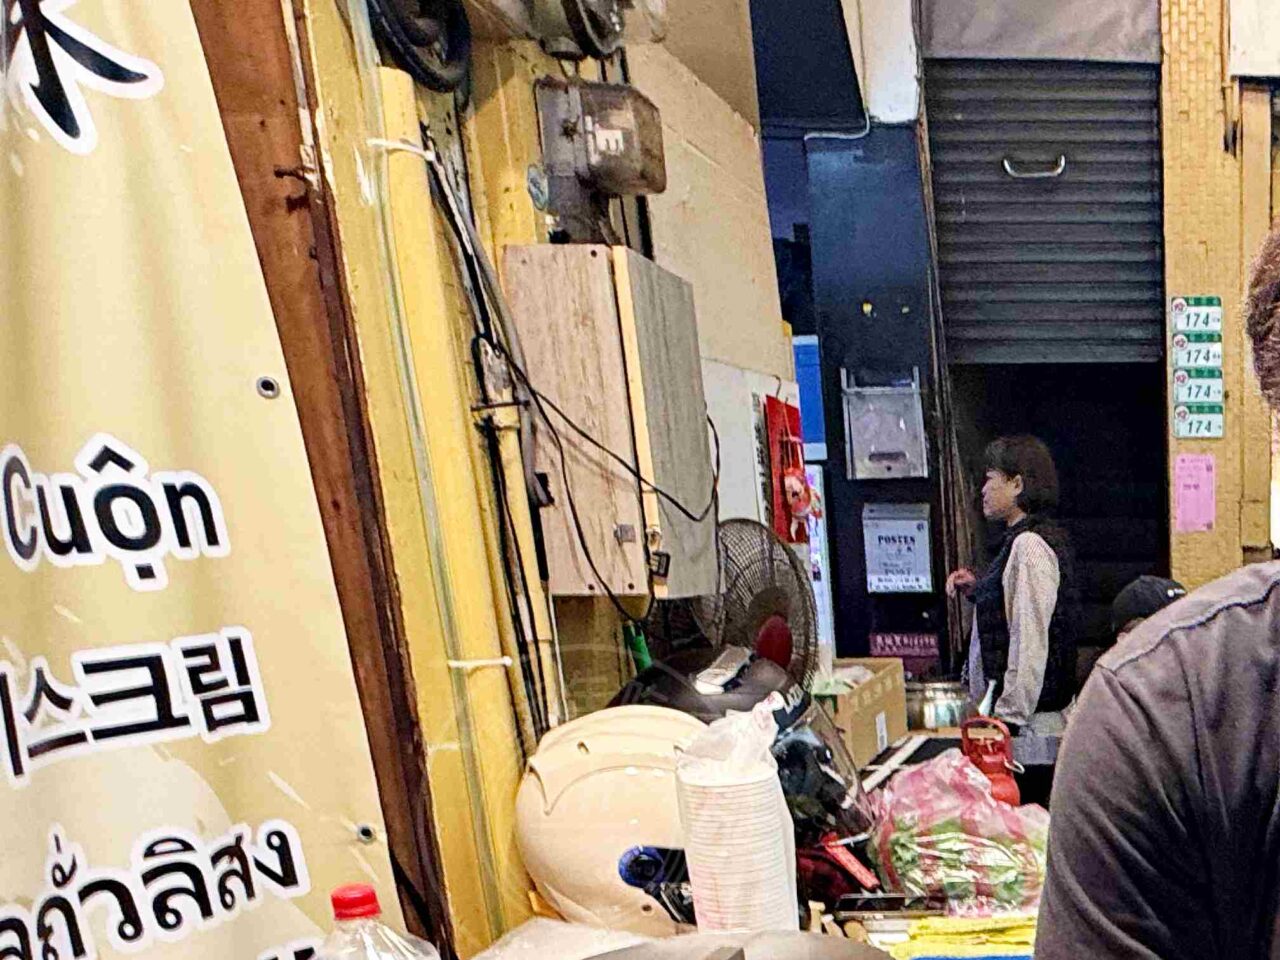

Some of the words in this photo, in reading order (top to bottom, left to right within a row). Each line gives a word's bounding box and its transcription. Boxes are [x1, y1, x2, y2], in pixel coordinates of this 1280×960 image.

[1185, 313, 1210, 327] 174
[1186, 349, 1210, 363] 174
[1187, 385, 1211, 398] 174
[1188, 421, 1212, 433] 174
[3, 445, 219, 579] Cuộn
